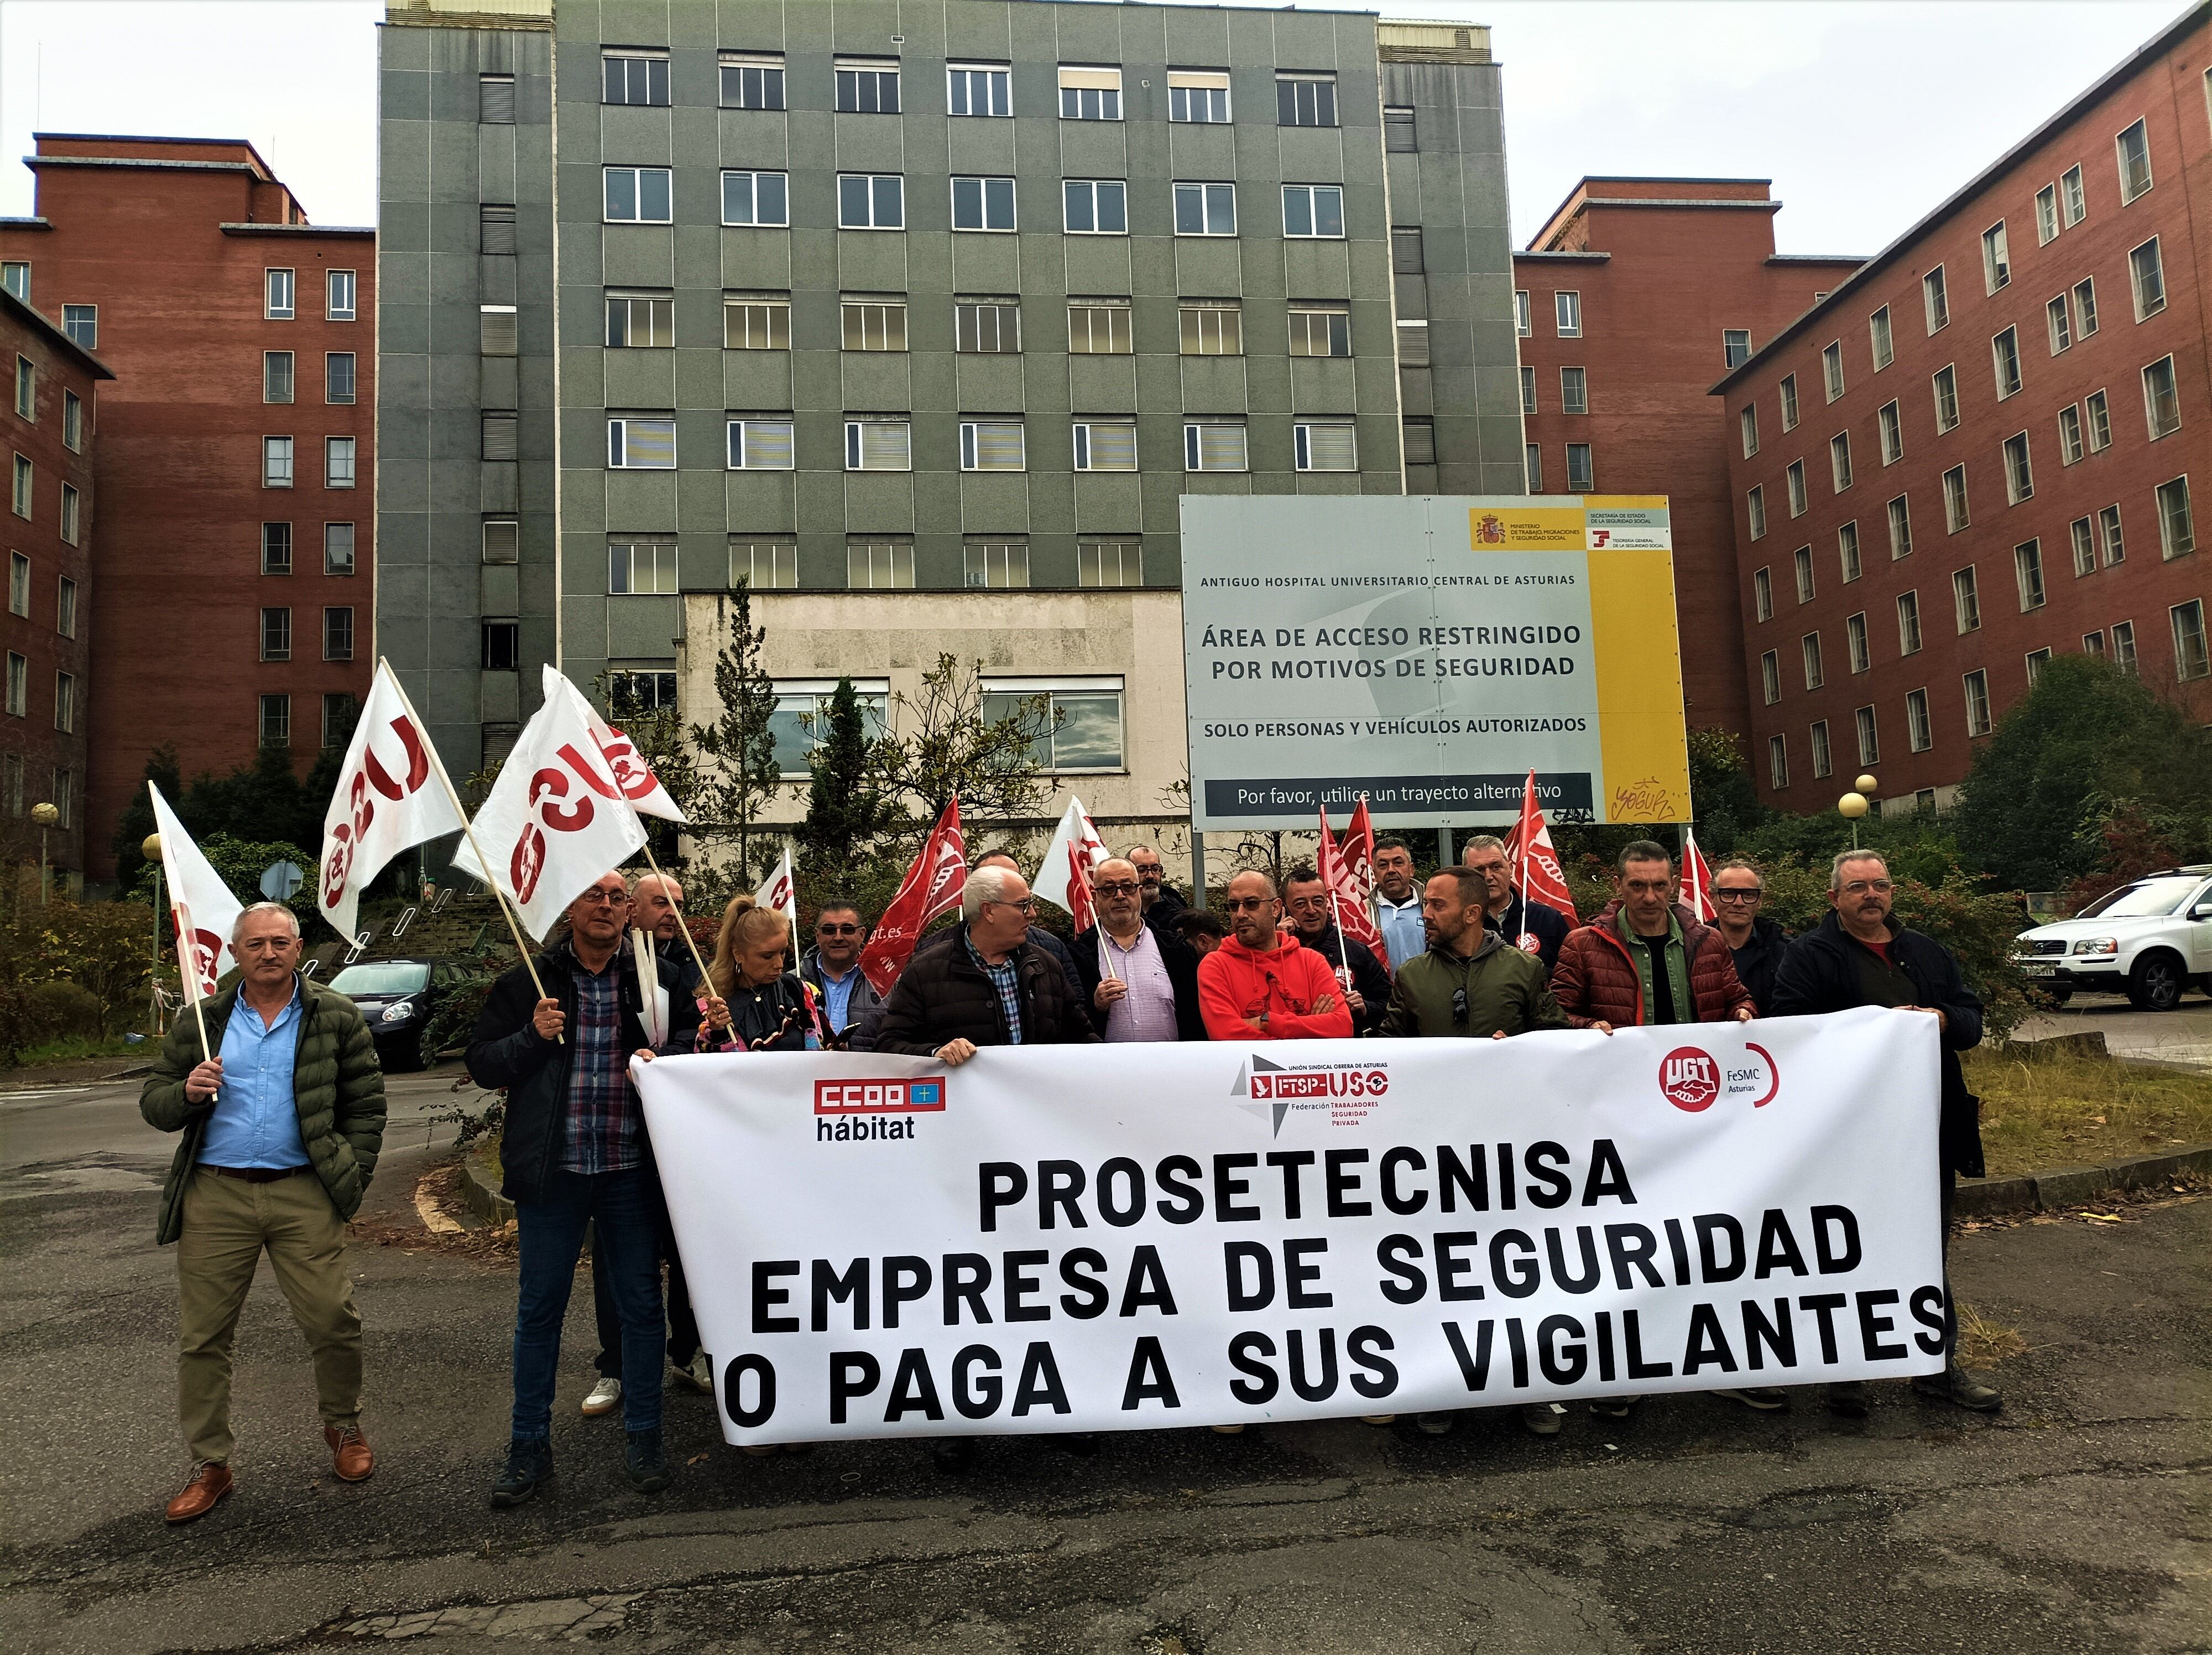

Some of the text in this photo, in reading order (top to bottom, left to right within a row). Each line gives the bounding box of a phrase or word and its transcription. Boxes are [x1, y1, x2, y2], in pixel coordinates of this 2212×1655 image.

[1201, 575, 1575, 587] ANTIGUO HOSPITAL UNIVERSITARIO CENTRAL DE ASTURIAS
[1202, 624, 1580, 647] ÁREA DE ACCESO RESTRINGIDO
[1212, 657, 1574, 679] POR MOTIVOS DE SEGURIDAD
[1204, 717, 1586, 737] SOLO PERSONAS Y VEHÍCULOS AUTORIZADOS
[1238, 789, 1265, 804] Por
[1270, 787, 1315, 806] favor,
[1321, 786, 1370, 803] utilice
[1376, 789, 1396, 802] un
[1401, 786, 1469, 804] trayecto
[1666, 1057, 1710, 1083] UGT
[1727, 1069, 1760, 1082] FeSMC
[821, 1085, 904, 1107] CCOO
[1728, 1084, 1755, 1092] Asturias
[817, 1115, 915, 1141] hábitat
[979, 1139, 1637, 1232] PROSETECNISA
[752, 1205, 1862, 1334] EMPRESA DE SEGURIDAD
[830, 1341, 1072, 1424] PAGA
[1121, 1336, 1181, 1410] A
[1228, 1325, 1399, 1405] SUS
[1440, 1286, 1945, 1392] VIGILANTES
